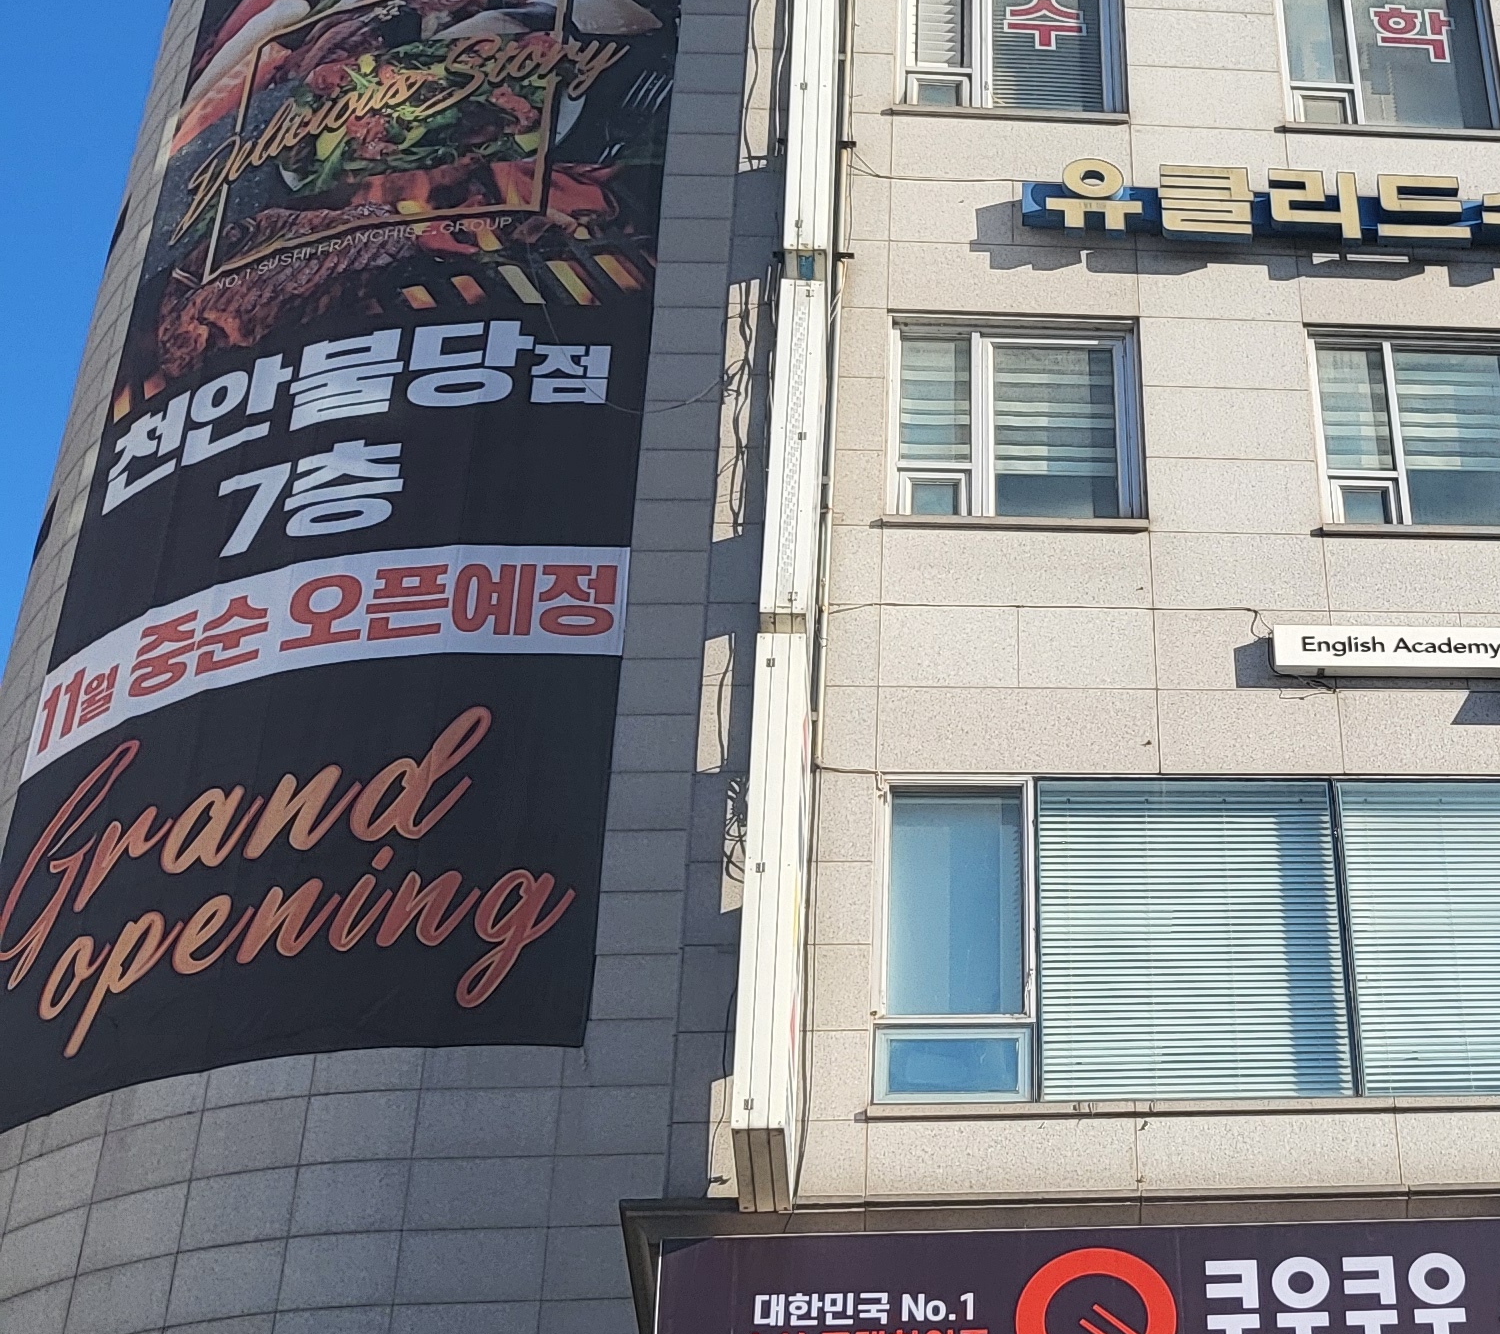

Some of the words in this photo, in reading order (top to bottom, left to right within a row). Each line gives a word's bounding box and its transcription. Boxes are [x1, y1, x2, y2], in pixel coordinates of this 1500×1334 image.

[101, 320, 613, 516] 천안불당점
[218, 440, 405, 558] 7층
[36, 663, 116, 755] 11월
[127, 593, 270, 698] 중순
[1300, 635, 1387, 659] English
[0, 706, 493, 991] Grand
[37, 845, 578, 1058] opening
[752, 1292, 891, 1329] 대한민국
[899, 1292, 977, 1326] No.1
